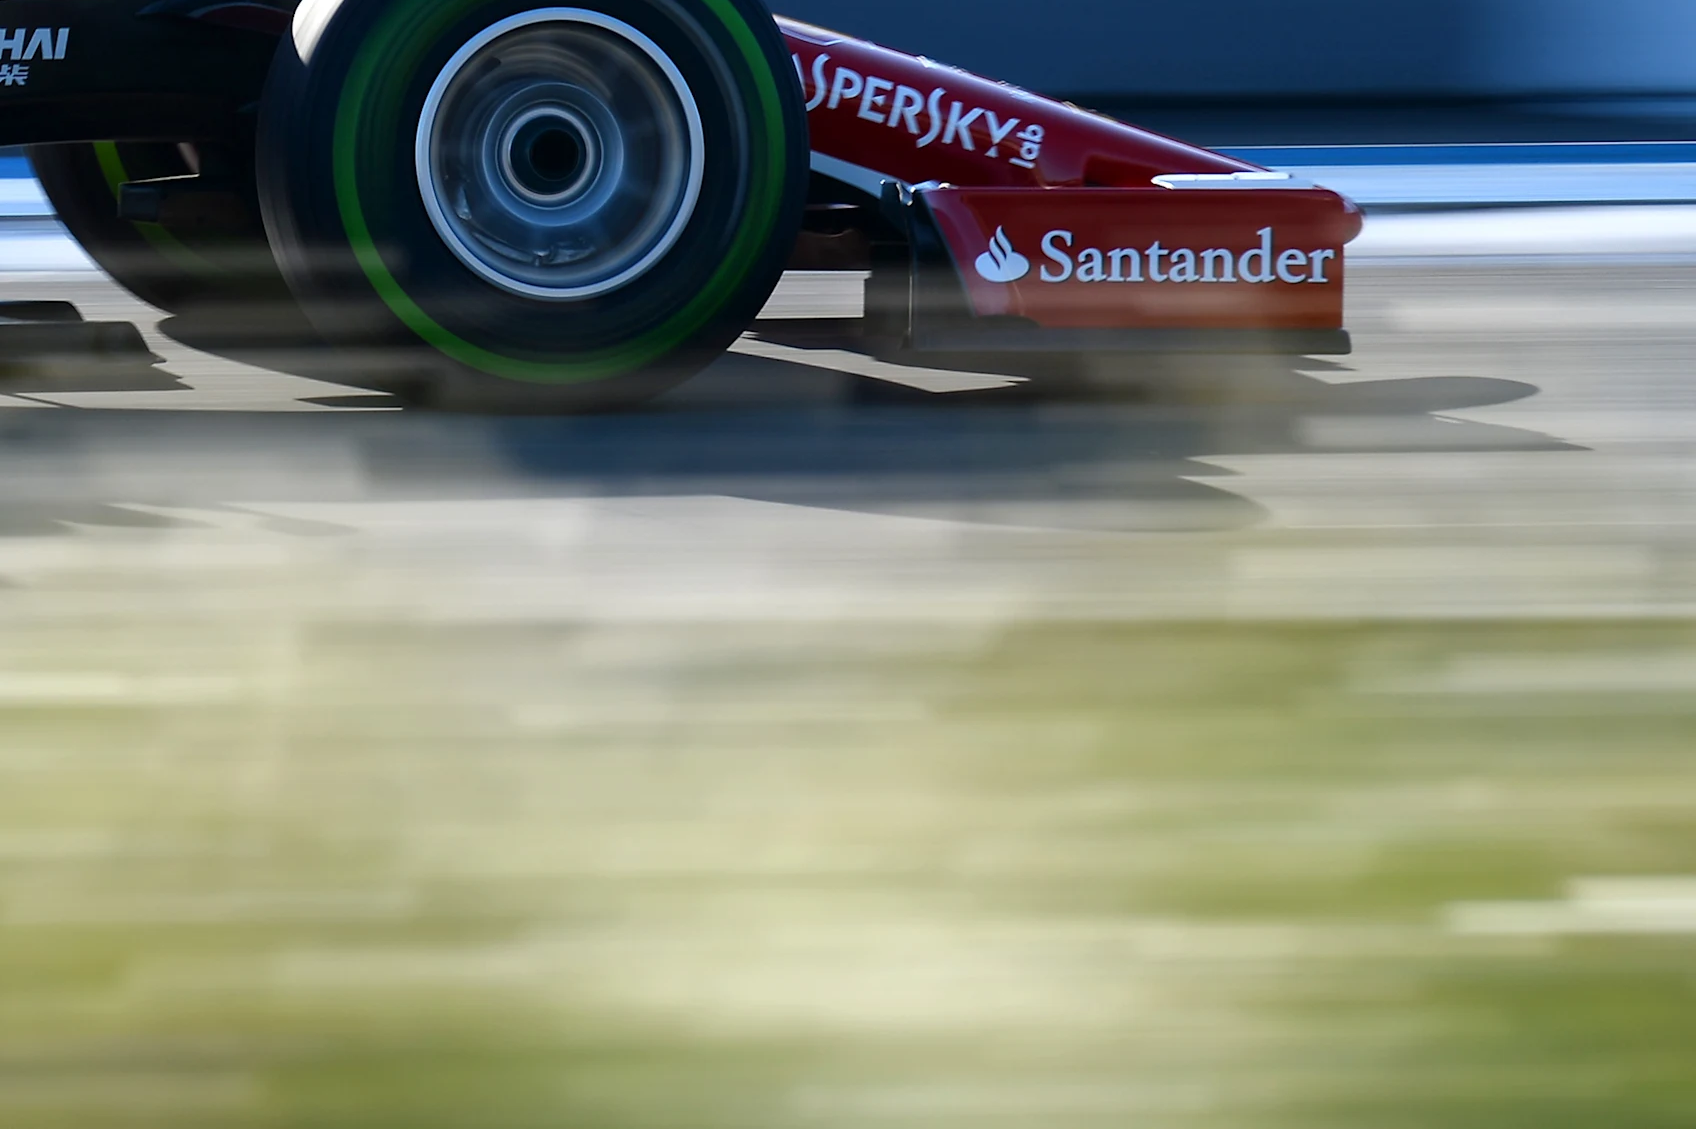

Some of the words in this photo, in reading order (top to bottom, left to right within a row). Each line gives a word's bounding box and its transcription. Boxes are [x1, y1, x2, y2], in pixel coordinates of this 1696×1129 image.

[791, 52, 1021, 159] SPERSKY
[1008, 123, 1044, 169] lab
[1039, 227, 1335, 284] Santander
